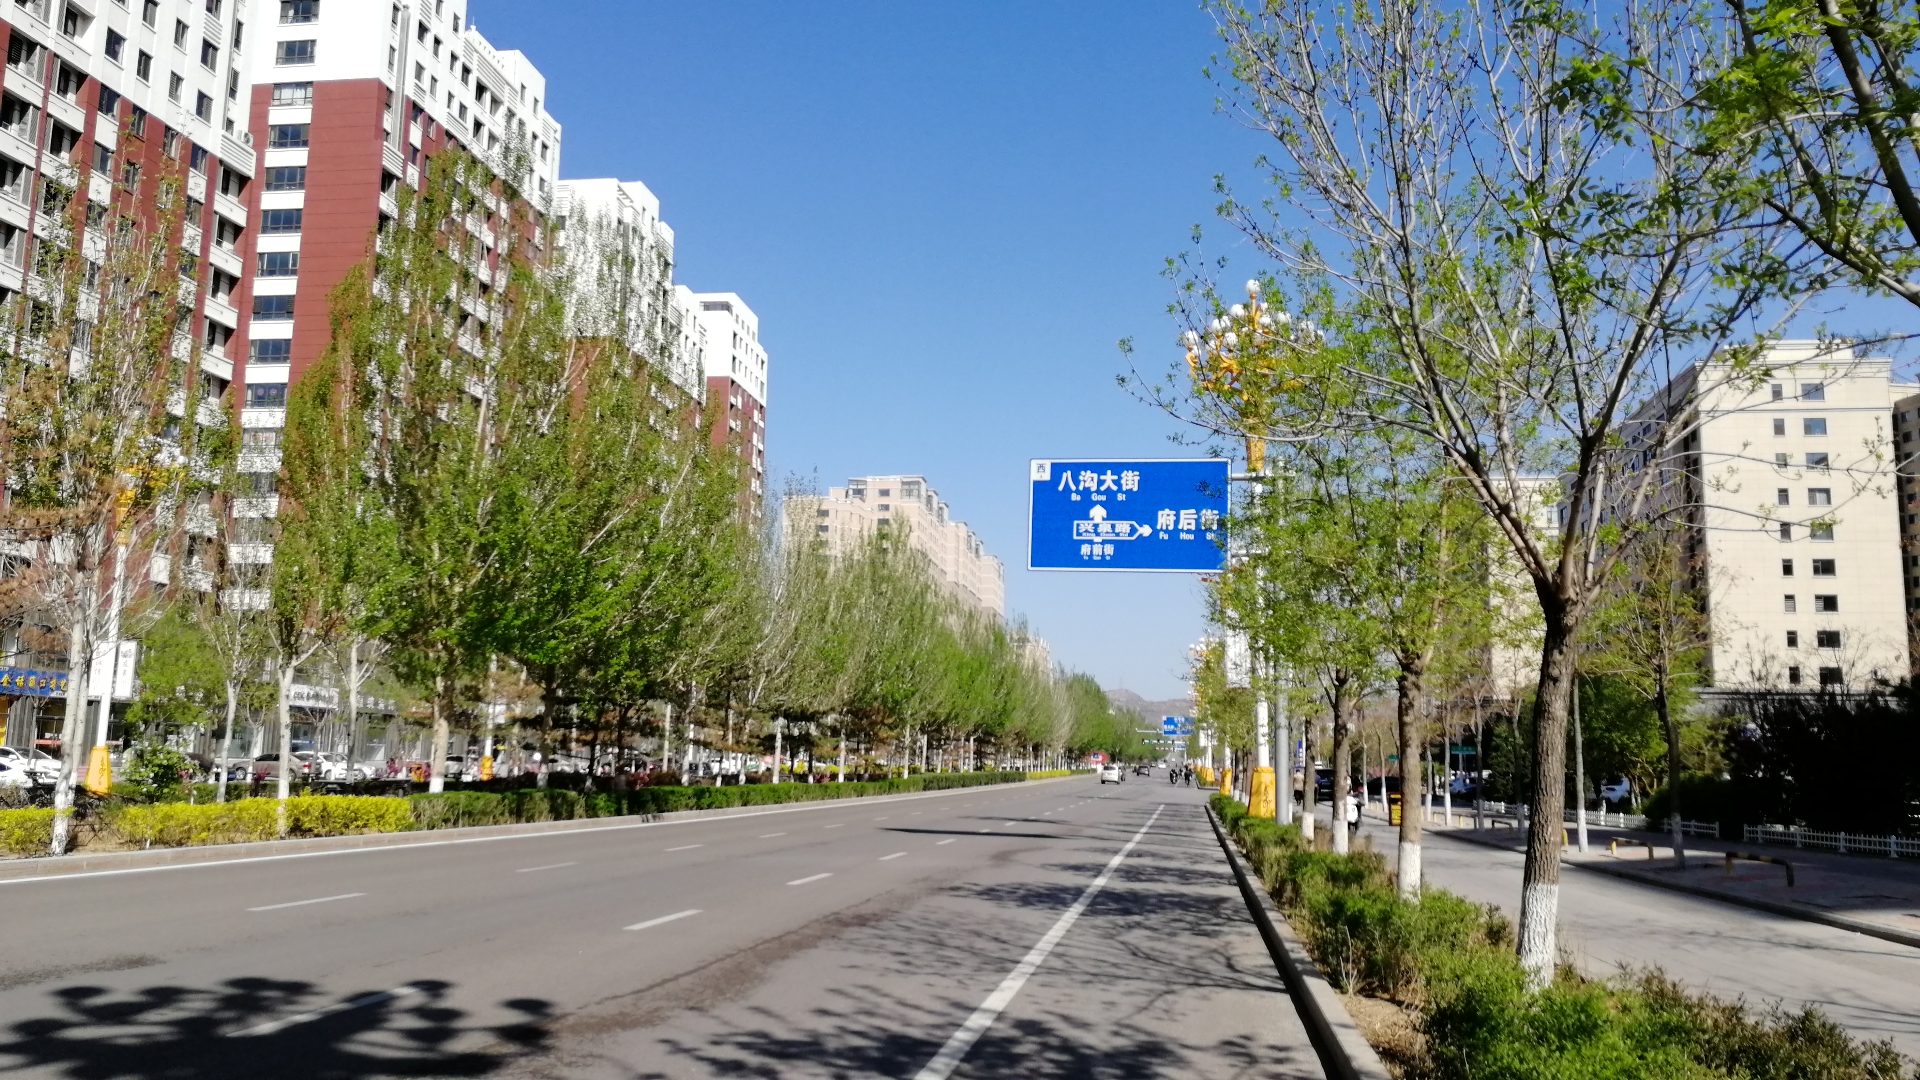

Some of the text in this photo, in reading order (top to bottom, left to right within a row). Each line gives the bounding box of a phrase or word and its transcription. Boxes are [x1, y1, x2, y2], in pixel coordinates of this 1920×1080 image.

[1037, 463, 1047, 473] 西
[1058, 470, 1140, 491] 八沟大街
[1071, 493, 1126, 501] Ba Gou St
[1156, 508, 1219, 530] 府后街
[1078, 523, 1131, 533] 兴泉路
[1159, 531, 1169, 540] Fu
[1180, 531, 1195, 540] Hou
[1081, 543, 1114, 556] 府前街
